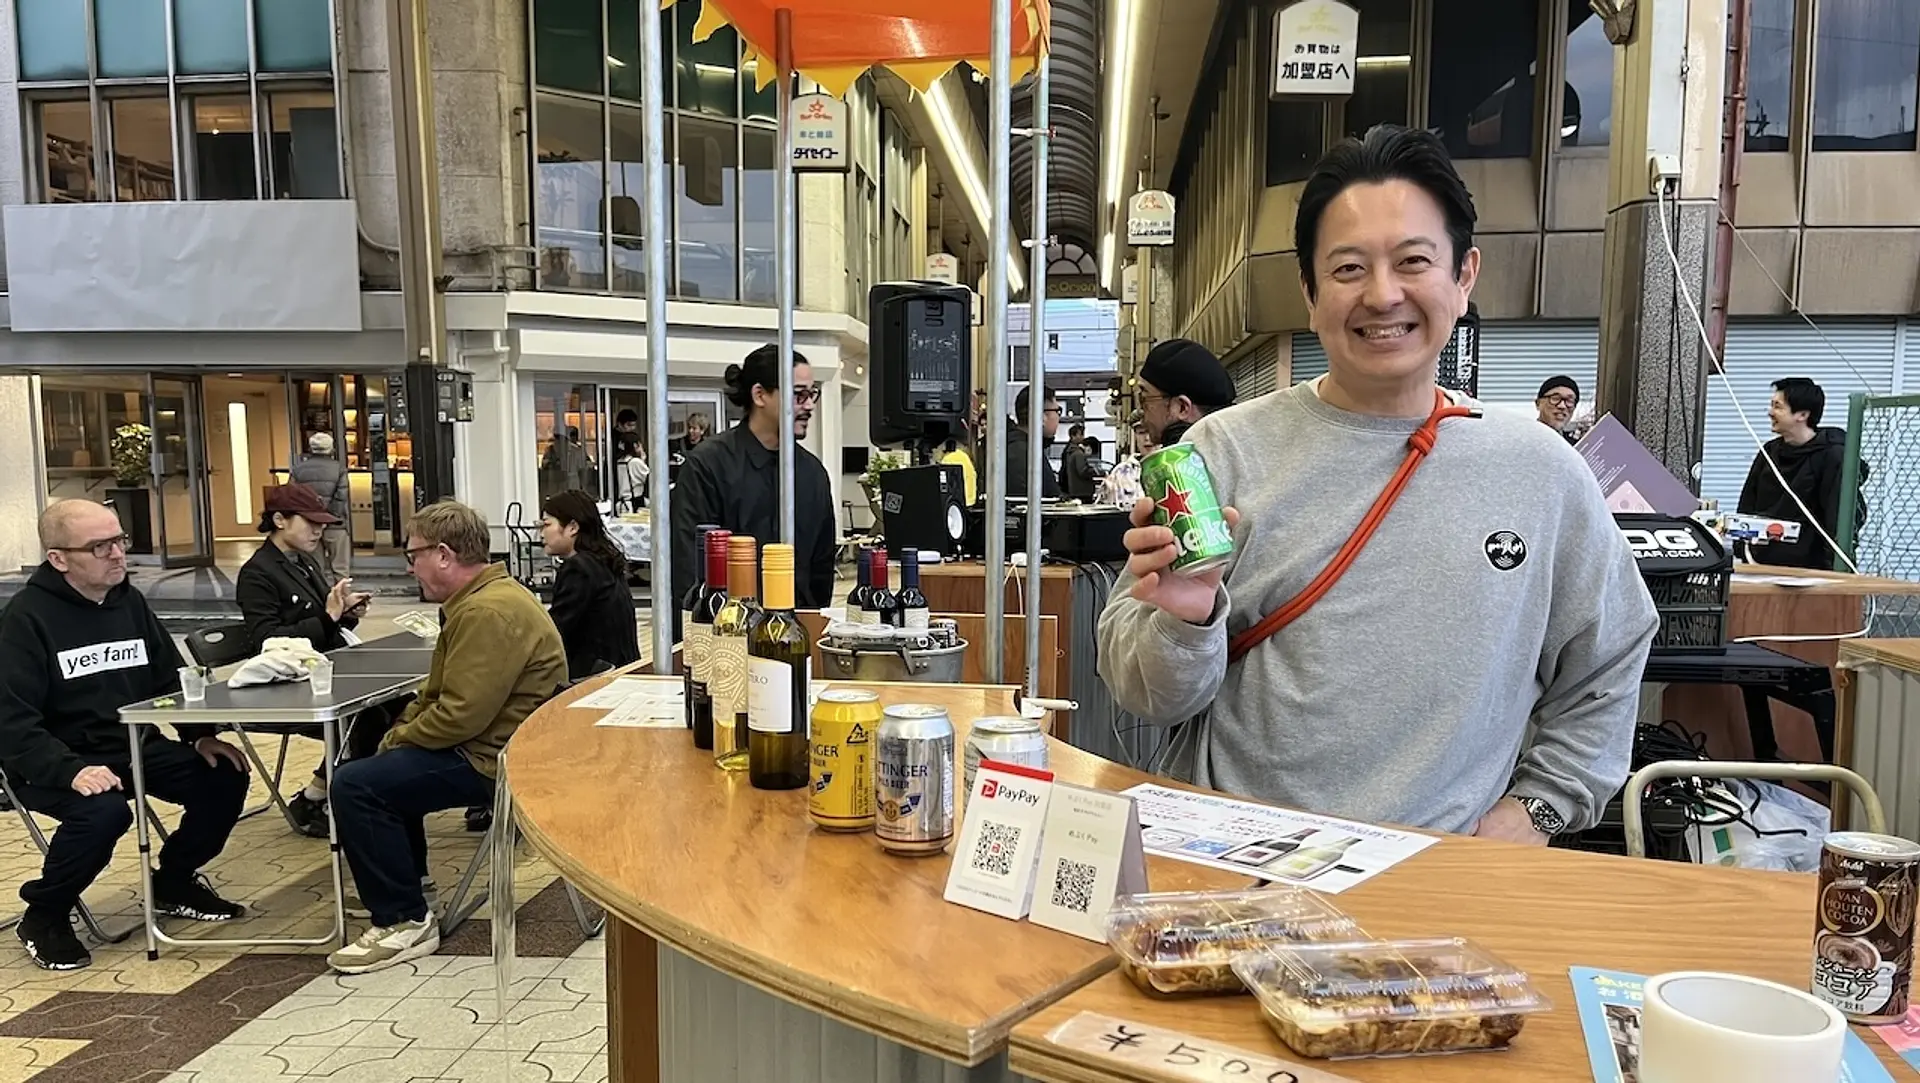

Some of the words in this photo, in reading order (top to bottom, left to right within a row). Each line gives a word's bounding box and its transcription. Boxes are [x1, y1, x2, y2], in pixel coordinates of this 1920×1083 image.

[1294, 43, 1341, 54] お買物は
[1281, 61, 1350, 80] 加盟店へ
[67, 652, 99, 675] yes
[103, 643, 139, 662] fam!
[998, 784, 1040, 806] PayPay
[1826, 898, 1874, 917] HOUTEN
[1837, 891, 1861, 905] VAN
[1826, 909, 1868, 927] COCOA
[1815, 969, 1878, 1001] ココア
